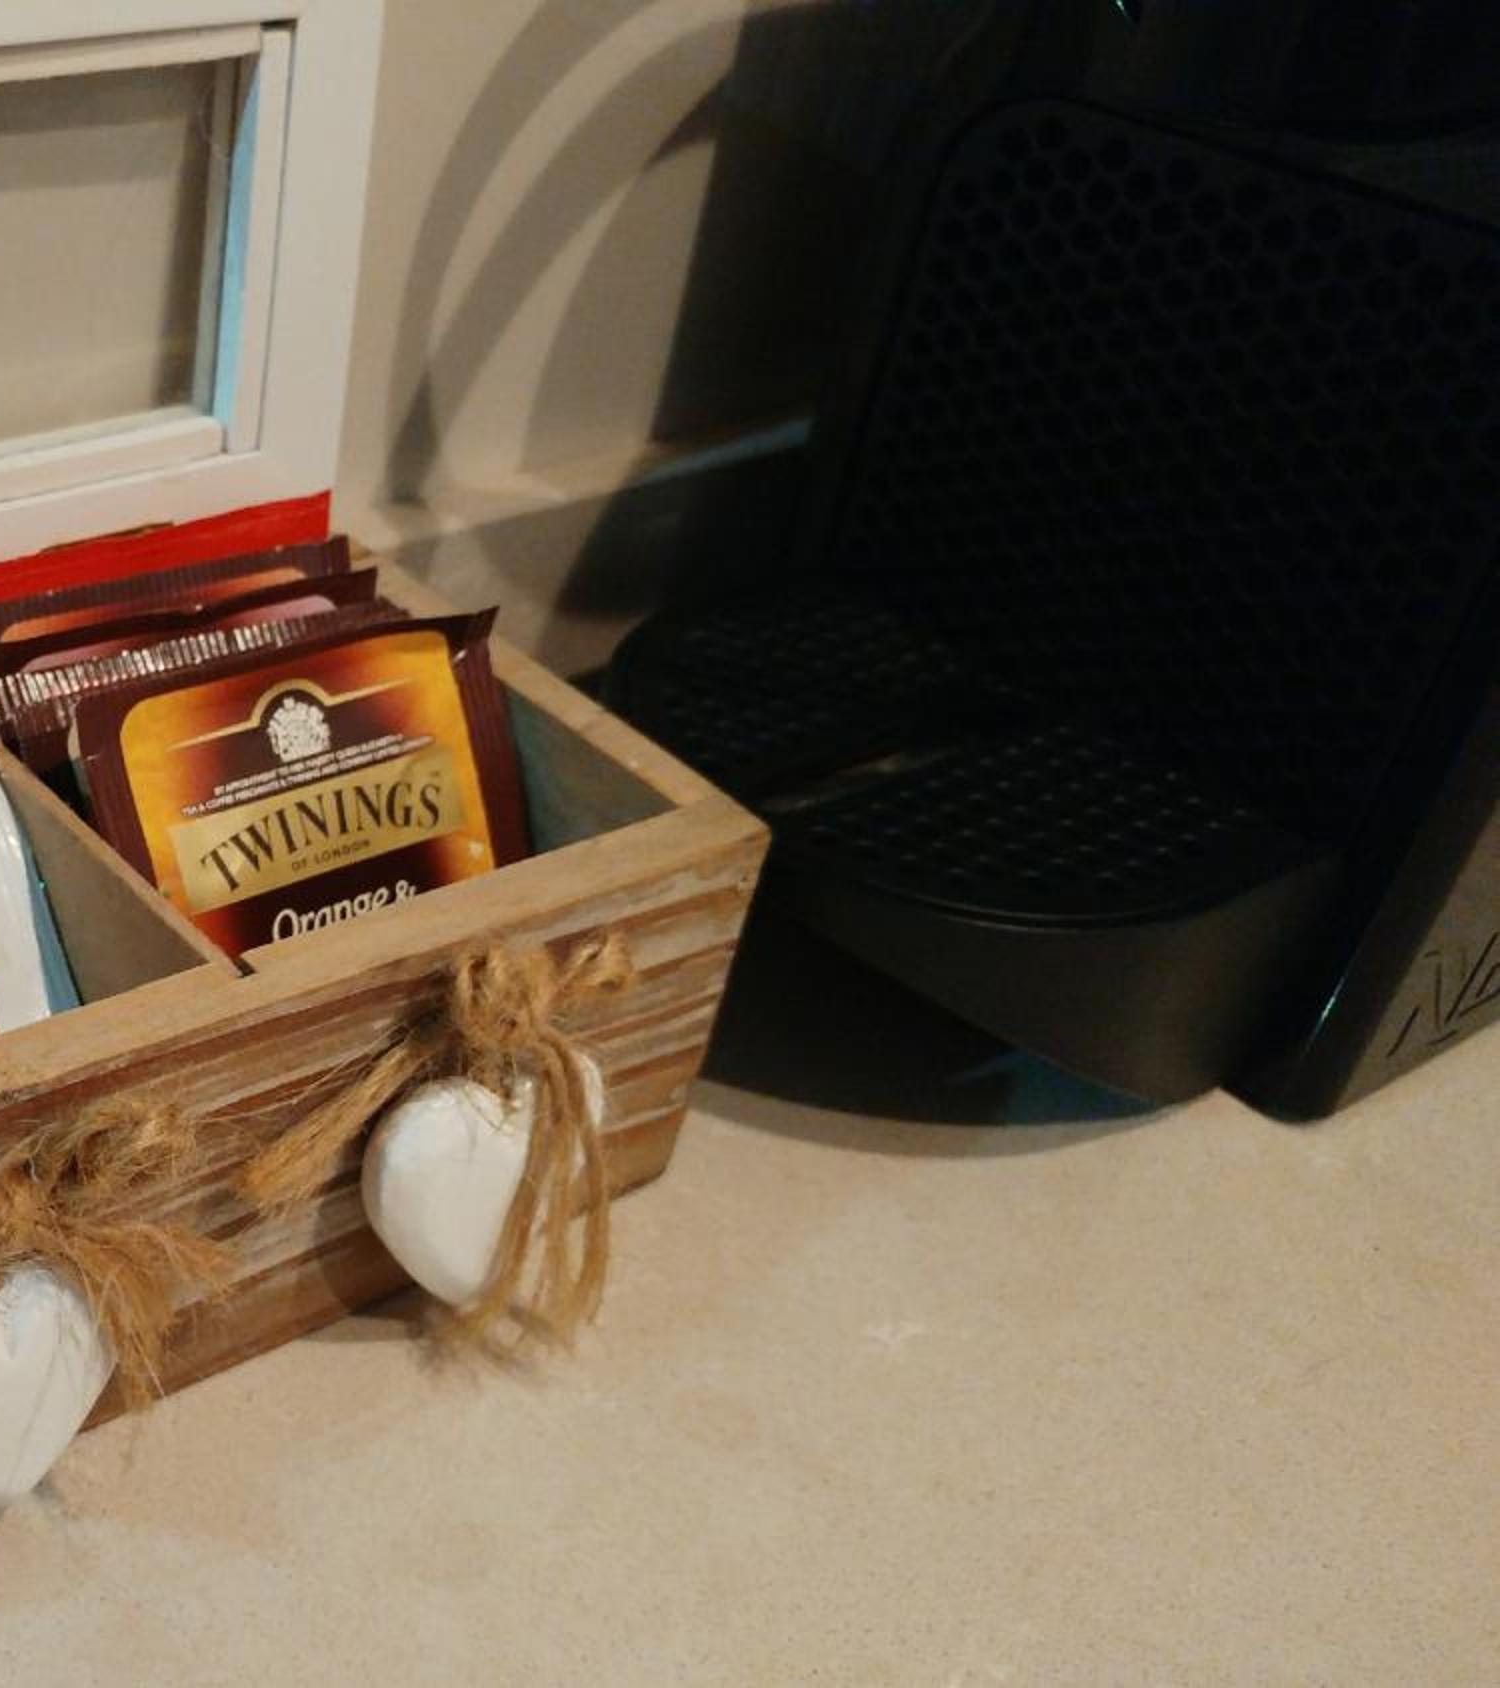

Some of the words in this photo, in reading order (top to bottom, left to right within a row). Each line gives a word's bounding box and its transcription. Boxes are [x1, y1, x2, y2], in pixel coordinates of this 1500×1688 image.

[200, 782, 441, 892] TWININGS
[292, 860, 308, 871] OF
[315, 839, 371, 863] LONDON
